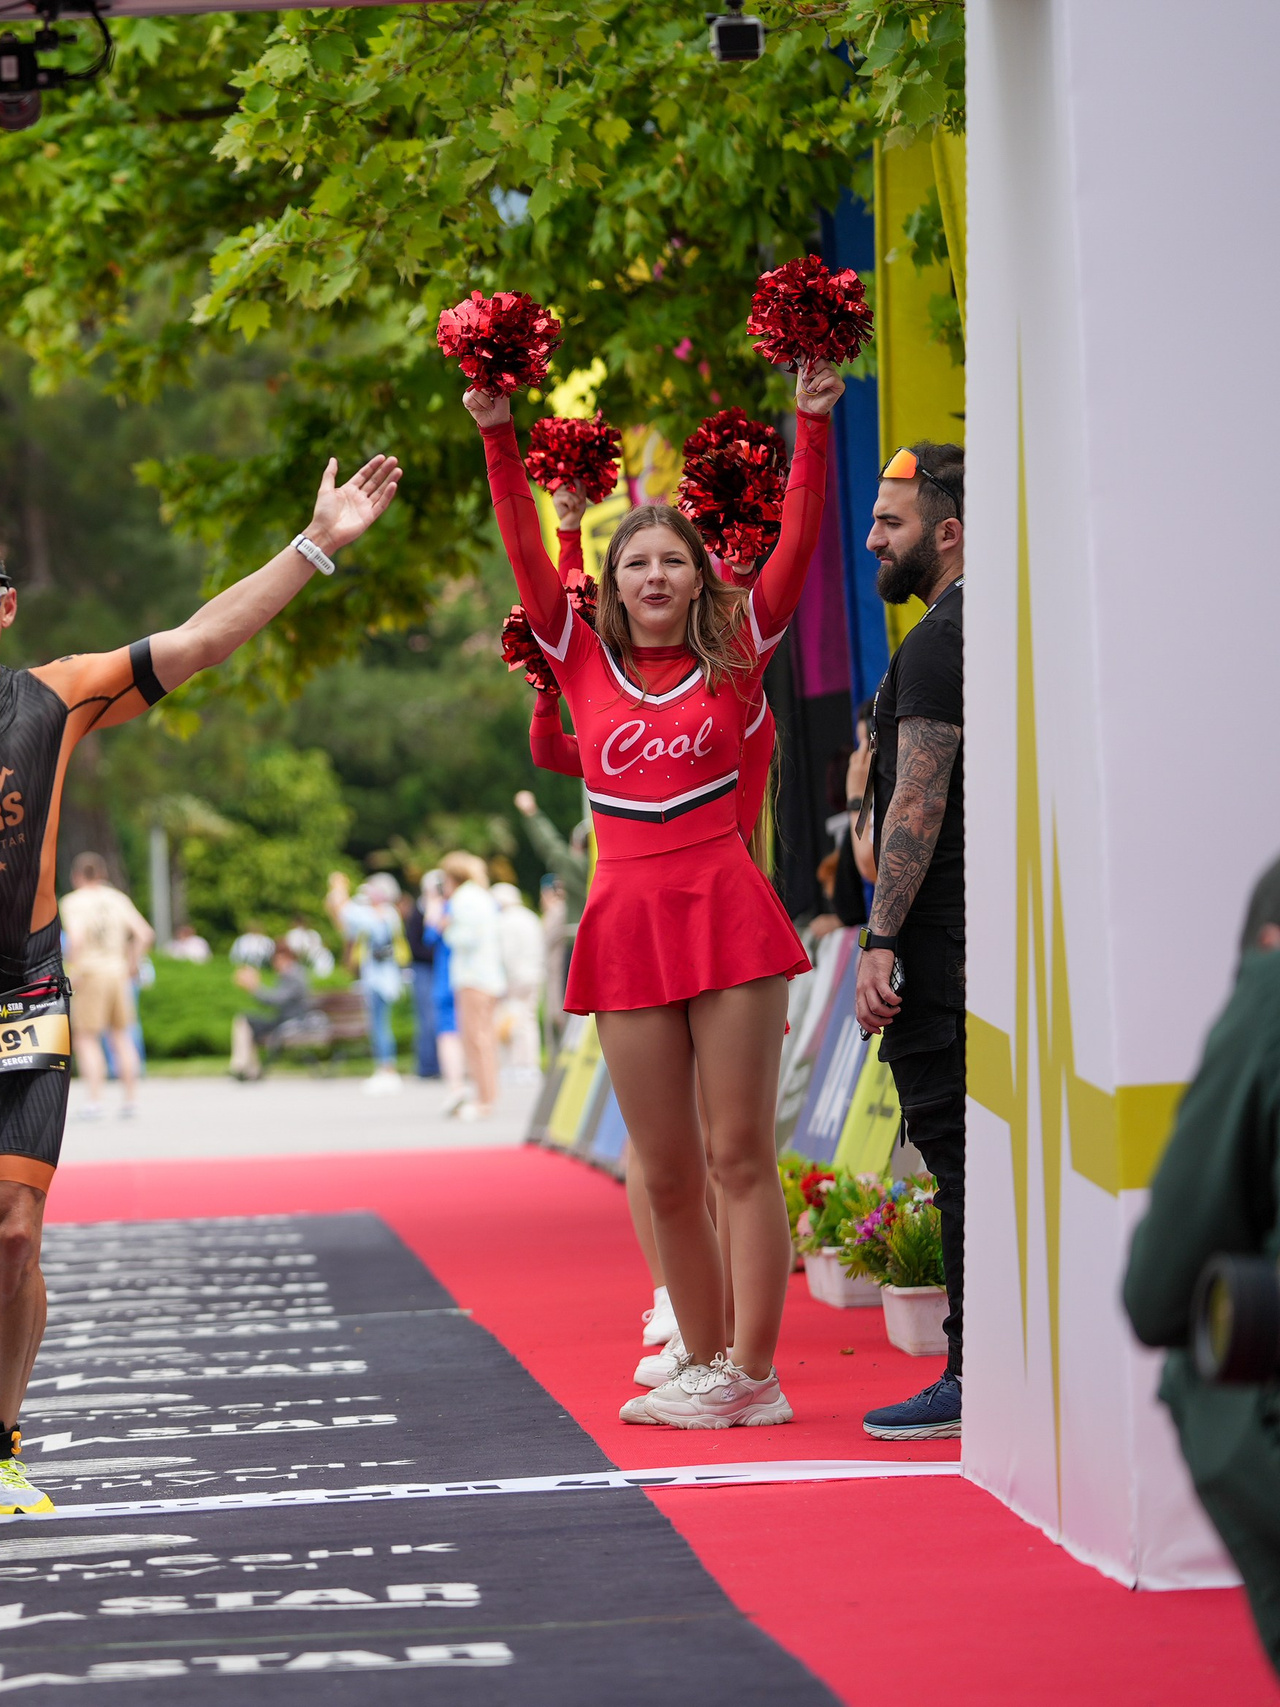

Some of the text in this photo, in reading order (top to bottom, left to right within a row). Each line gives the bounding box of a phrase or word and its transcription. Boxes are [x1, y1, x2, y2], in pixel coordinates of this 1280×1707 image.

[601, 716, 713, 776] Cool
[7, 1002, 24, 1011] STAR
[1, 1055, 34, 1067] SERGEY
[131, 1360, 367, 1379] STAR
[126, 1414, 398, 1438] STAR
[98, 1582, 479, 1615] STAR
[88, 1641, 512, 1679] STAR
